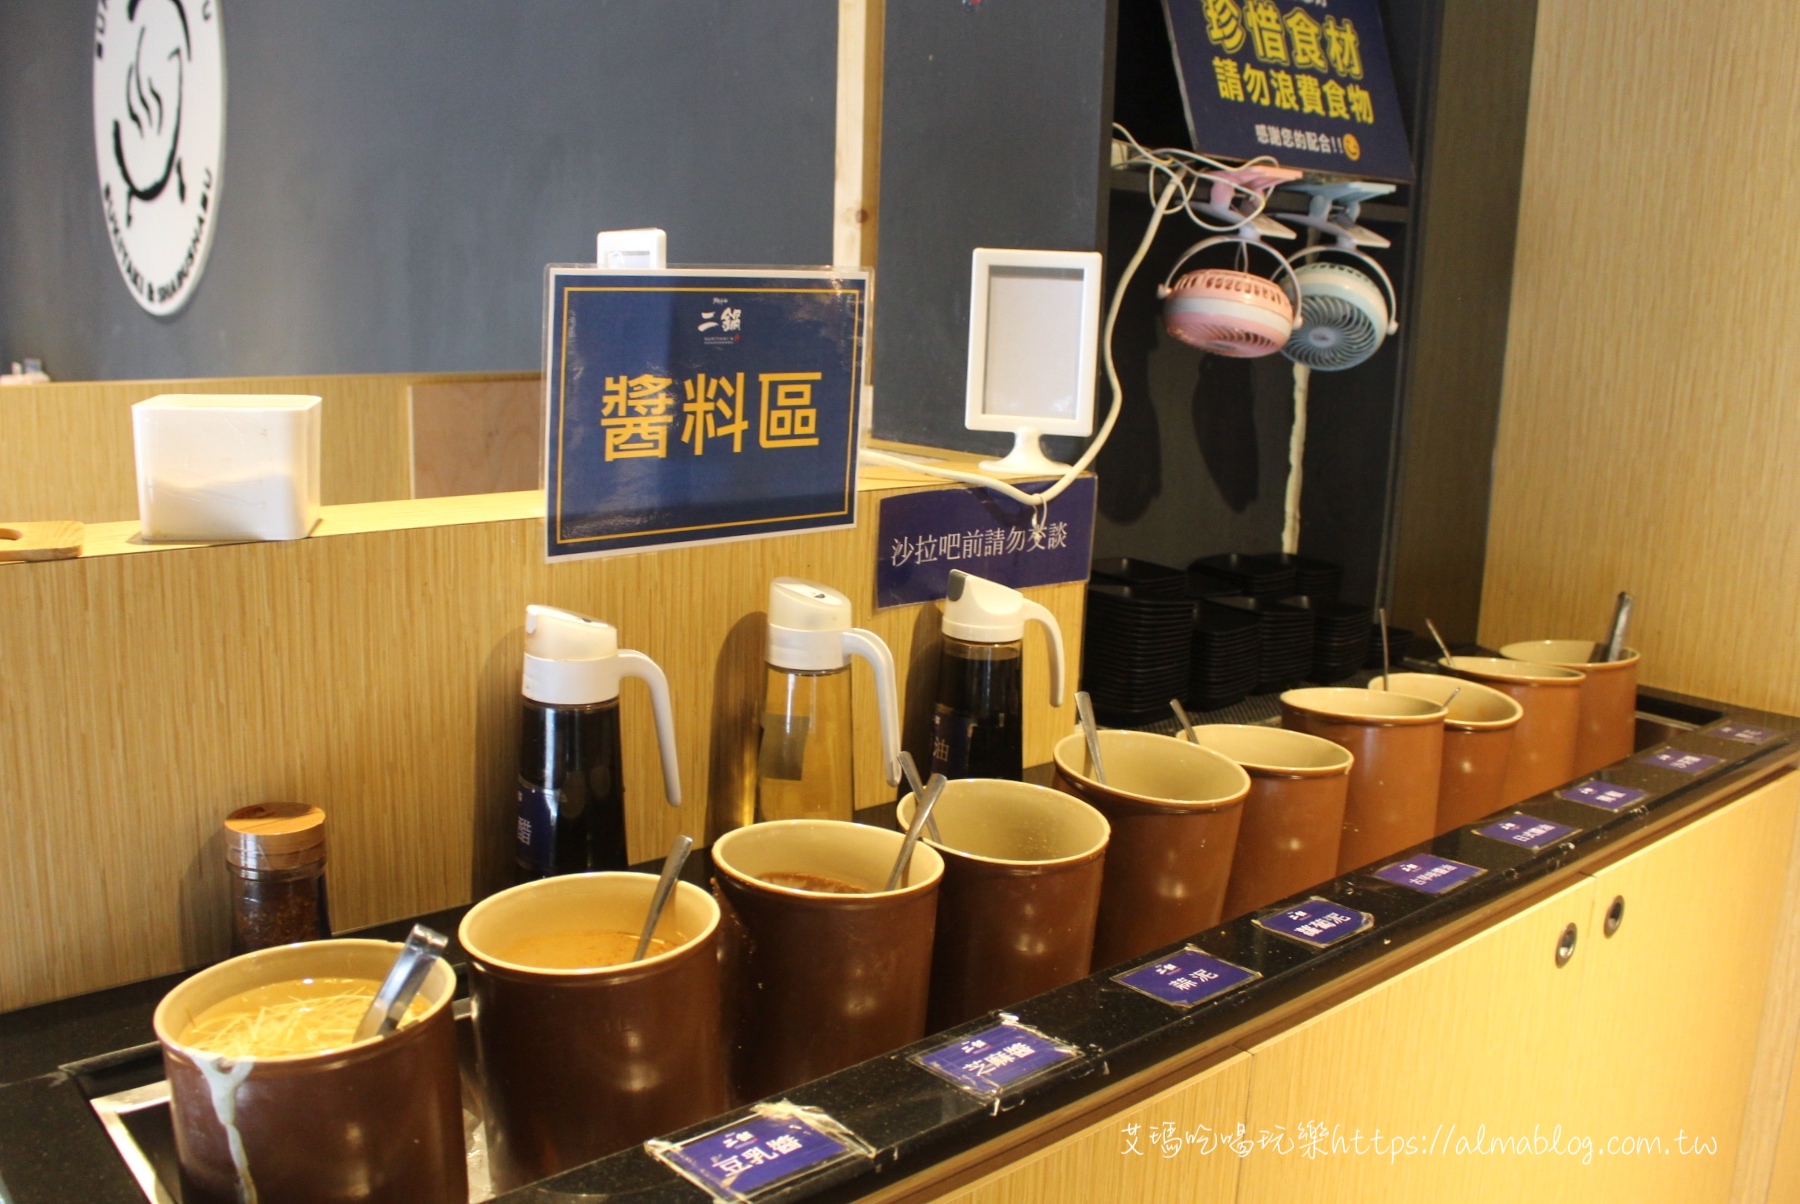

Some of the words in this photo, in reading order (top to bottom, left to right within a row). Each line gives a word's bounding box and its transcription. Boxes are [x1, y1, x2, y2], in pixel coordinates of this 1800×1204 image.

[1201, 0, 1363, 79] 珍惜食材
[1212, 56, 1375, 124] 請勿浪費食物
[697, 307, 742, 332] 二鍋
[600, 371, 822, 462] 醬料區
[891, 521, 1068, 567] 沙拉吧前請勿交談
[1167, 968, 1219, 991] 蒜泥
[962, 1042, 1036, 1076] 芝麻醬
[712, 1134, 803, 1177] 豆乳醬
